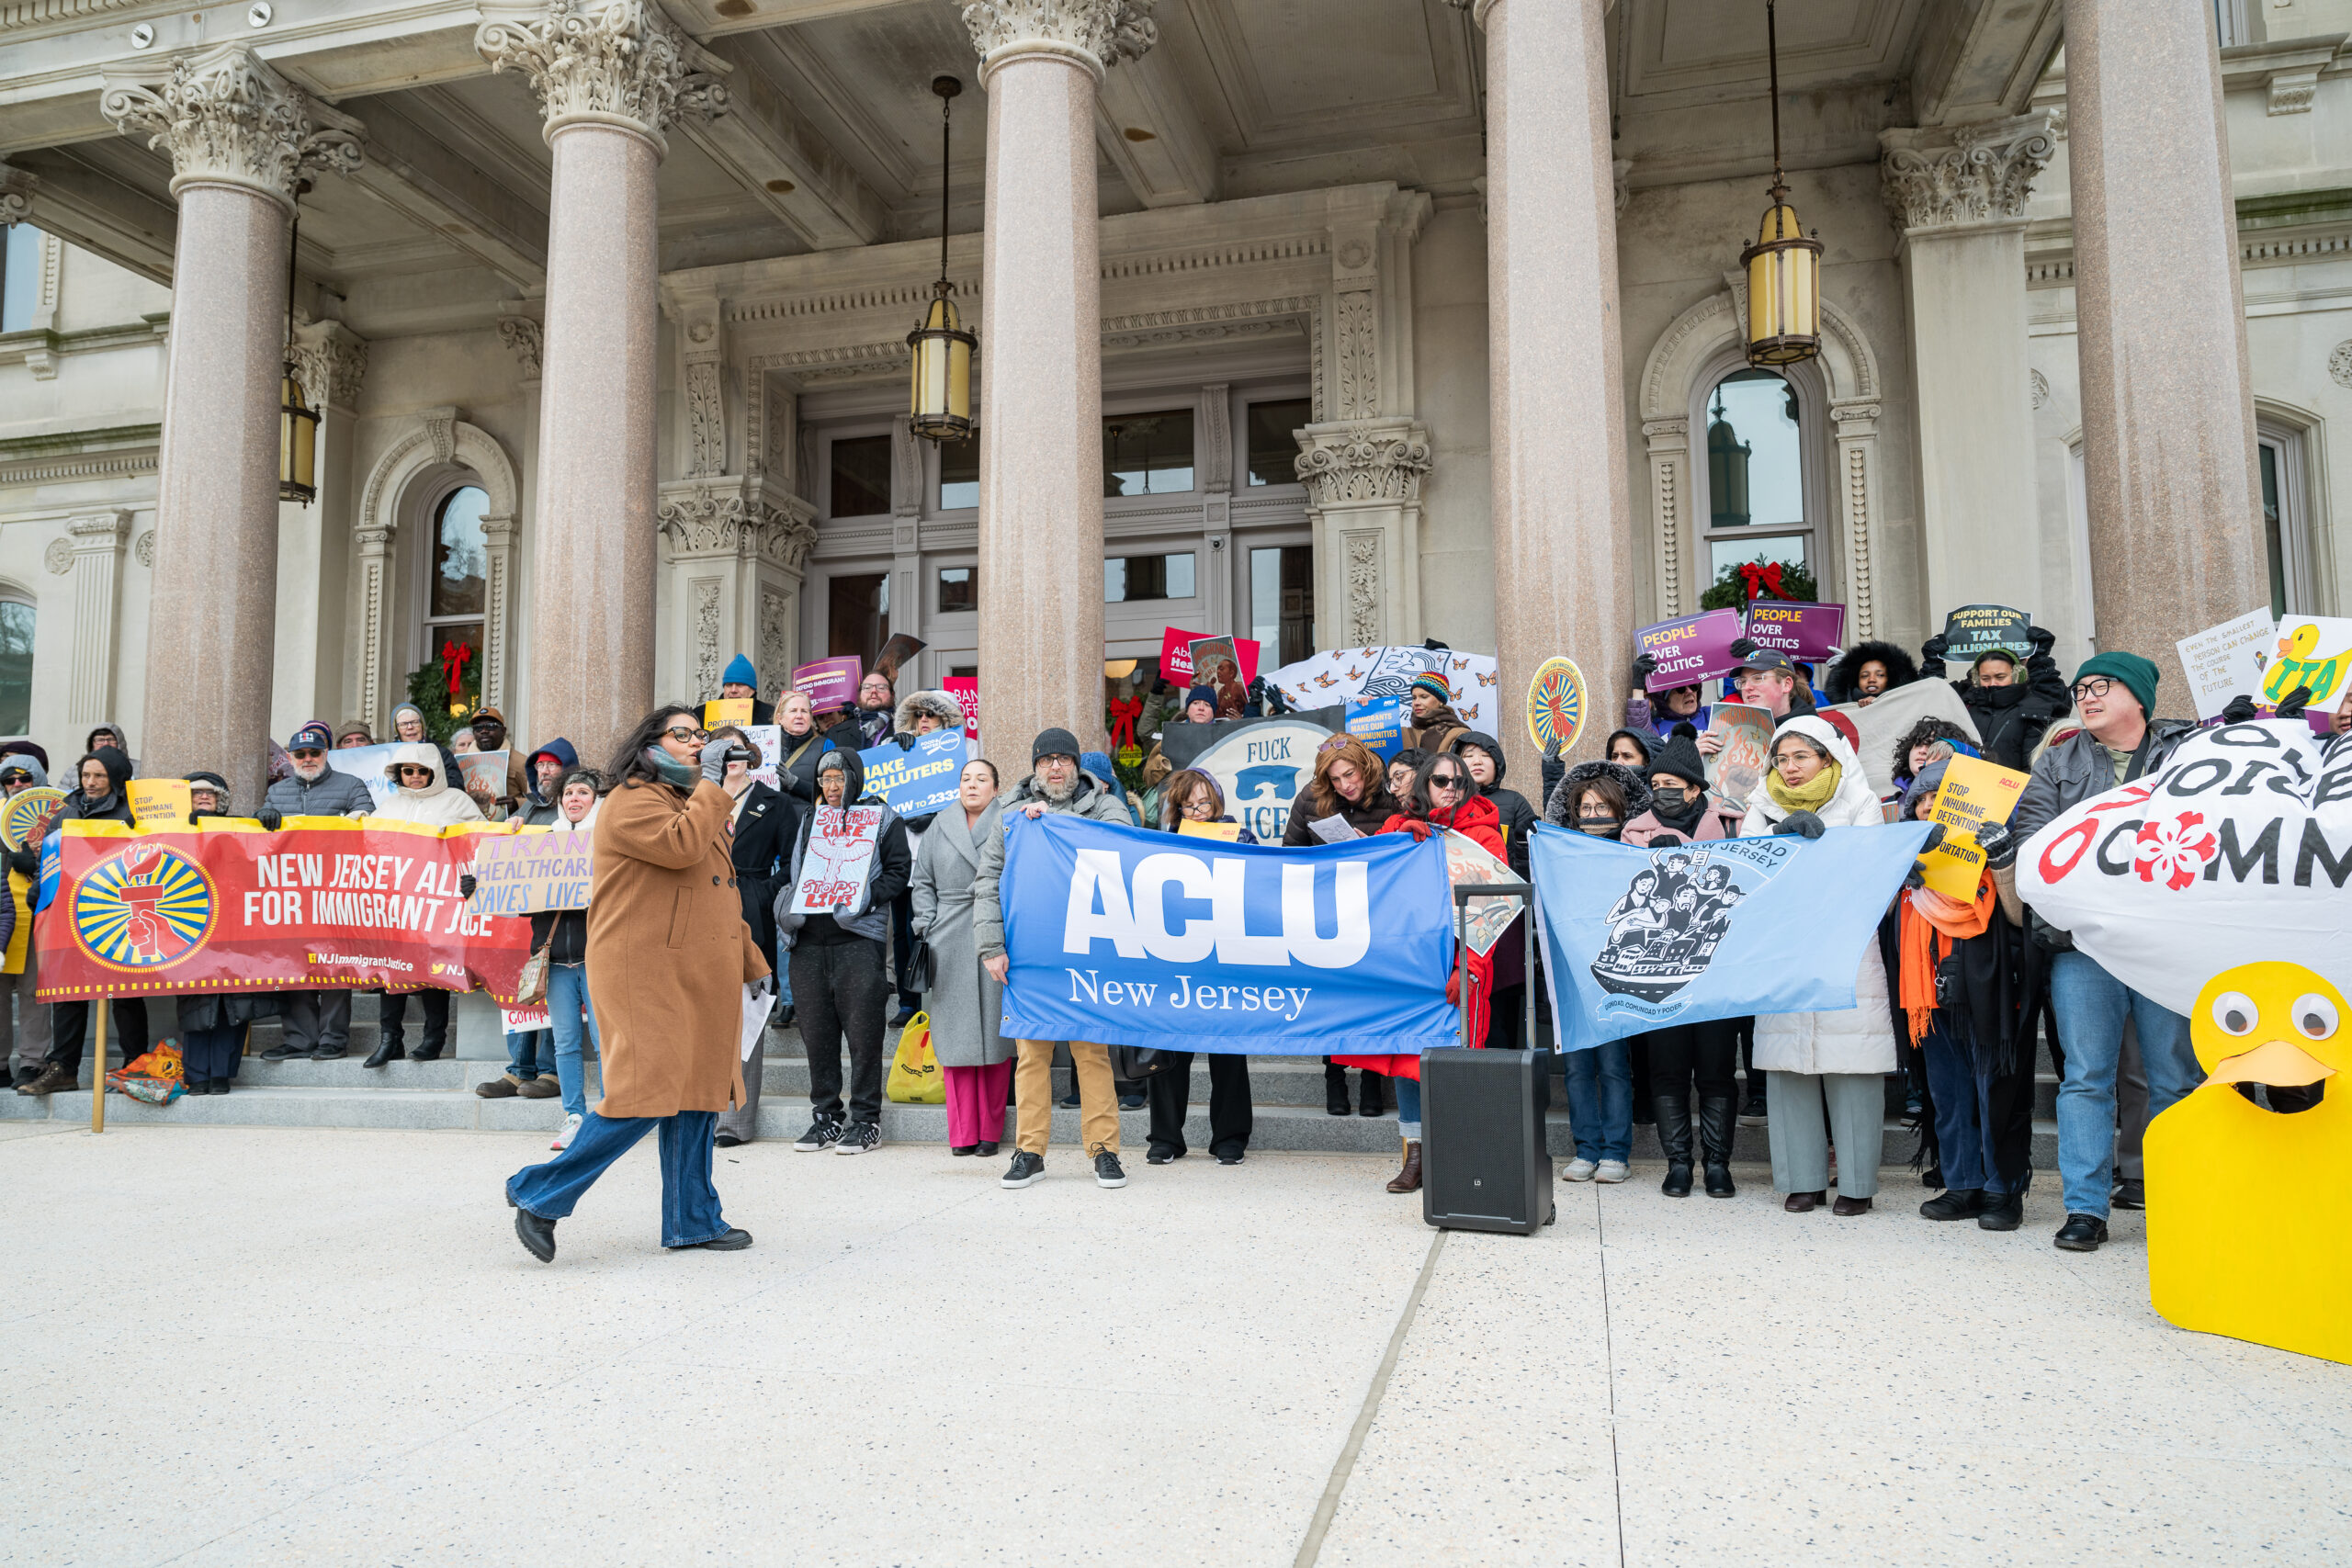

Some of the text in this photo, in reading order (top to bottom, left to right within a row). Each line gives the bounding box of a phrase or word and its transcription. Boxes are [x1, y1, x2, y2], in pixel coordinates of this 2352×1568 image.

[1754, 609, 1803, 622] PEOPLE
[1952, 610, 2023, 620] SUPPORT OUR
[1752, 624, 1782, 635] OVER
[1961, 618, 2012, 628] FAMILIES
[1643, 624, 1697, 648] PEOPLE
[1751, 637, 1800, 649] POLITICS
[1970, 629, 2003, 642] TAX
[1648, 645, 1681, 660] OVER
[2222, 639, 2238, 651] CAN
[814, 677, 845, 687] IMMIGRANT
[2201, 677, 2233, 696] FUTURE
[2266, 658, 2336, 701] ITA
[707, 719, 745, 728] PROTECT
[1351, 713, 1392, 724] IMMIGRANTS
[1351, 722, 1385, 732] MAKE OUR
[1248, 737, 1291, 763] FUCK
[1363, 739, 1386, 750] ONGER
[1947, 783, 1970, 797] STOP
[1998, 777, 2020, 789] ACLU
[134, 796, 153, 805] STOP
[915, 800, 927, 809] TO
[1941, 795, 1985, 818] INHUMANE
[135, 803, 174, 814] INHUMANE
[1244, 807, 1289, 840] ICE
[1937, 809, 1982, 832] DETENTION
[822, 824, 866, 837] CARE
[487, 831, 594, 860] TRAN
[1939, 841, 1980, 864] ORTATION
[1721, 843, 1778, 869] JERSEY
[257, 853, 322, 887] NEW
[330, 854, 413, 890] JERSEY
[802, 879, 859, 897] STOPS
[469, 882, 591, 914] SAVES LIVE
[805, 893, 853, 908] LIVES
[244, 891, 302, 926] FOR
[311, 891, 445, 932] IMMIGRANT
[1062, 848, 1371, 969] ACLU
[318, 953, 466, 976] NJImmigrantJustice NJ
[1065, 968, 1312, 1022] New Jersey
[1625, 1001, 1657, 1015] COMUNIDAD
[1662, 1002, 1682, 1014] PODER
[508, 1010, 549, 1025] Corrup
